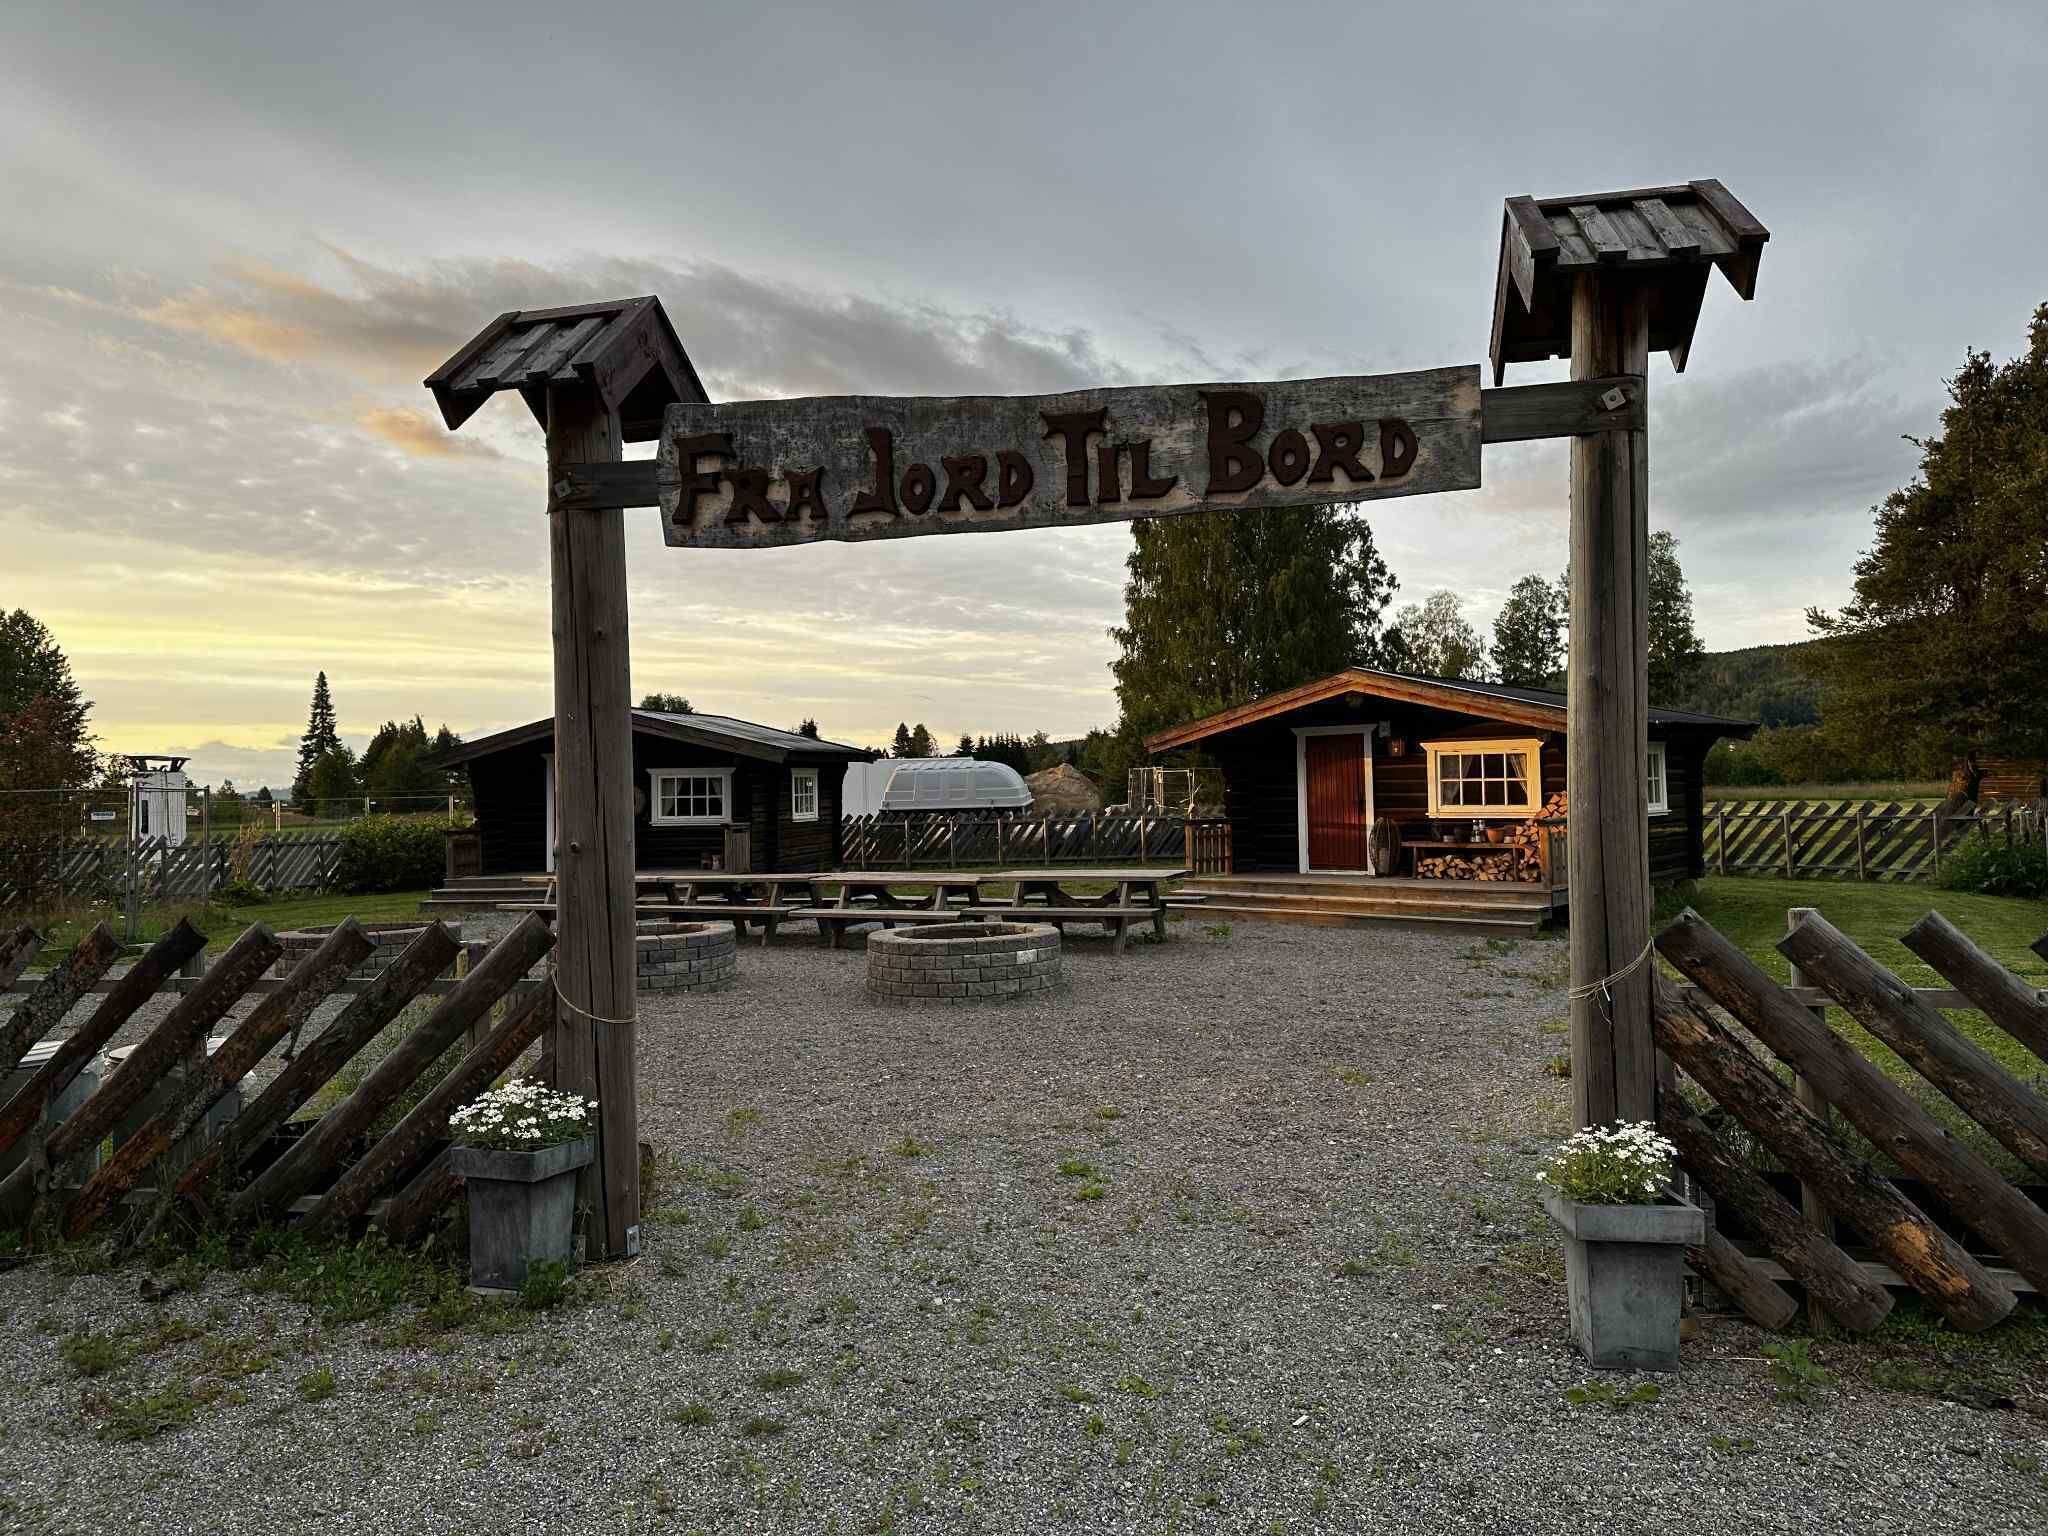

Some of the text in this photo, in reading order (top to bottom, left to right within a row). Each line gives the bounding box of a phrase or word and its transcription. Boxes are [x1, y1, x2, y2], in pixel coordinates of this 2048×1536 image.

[672, 391, 1419, 524] FRA JORD TIL BORD
